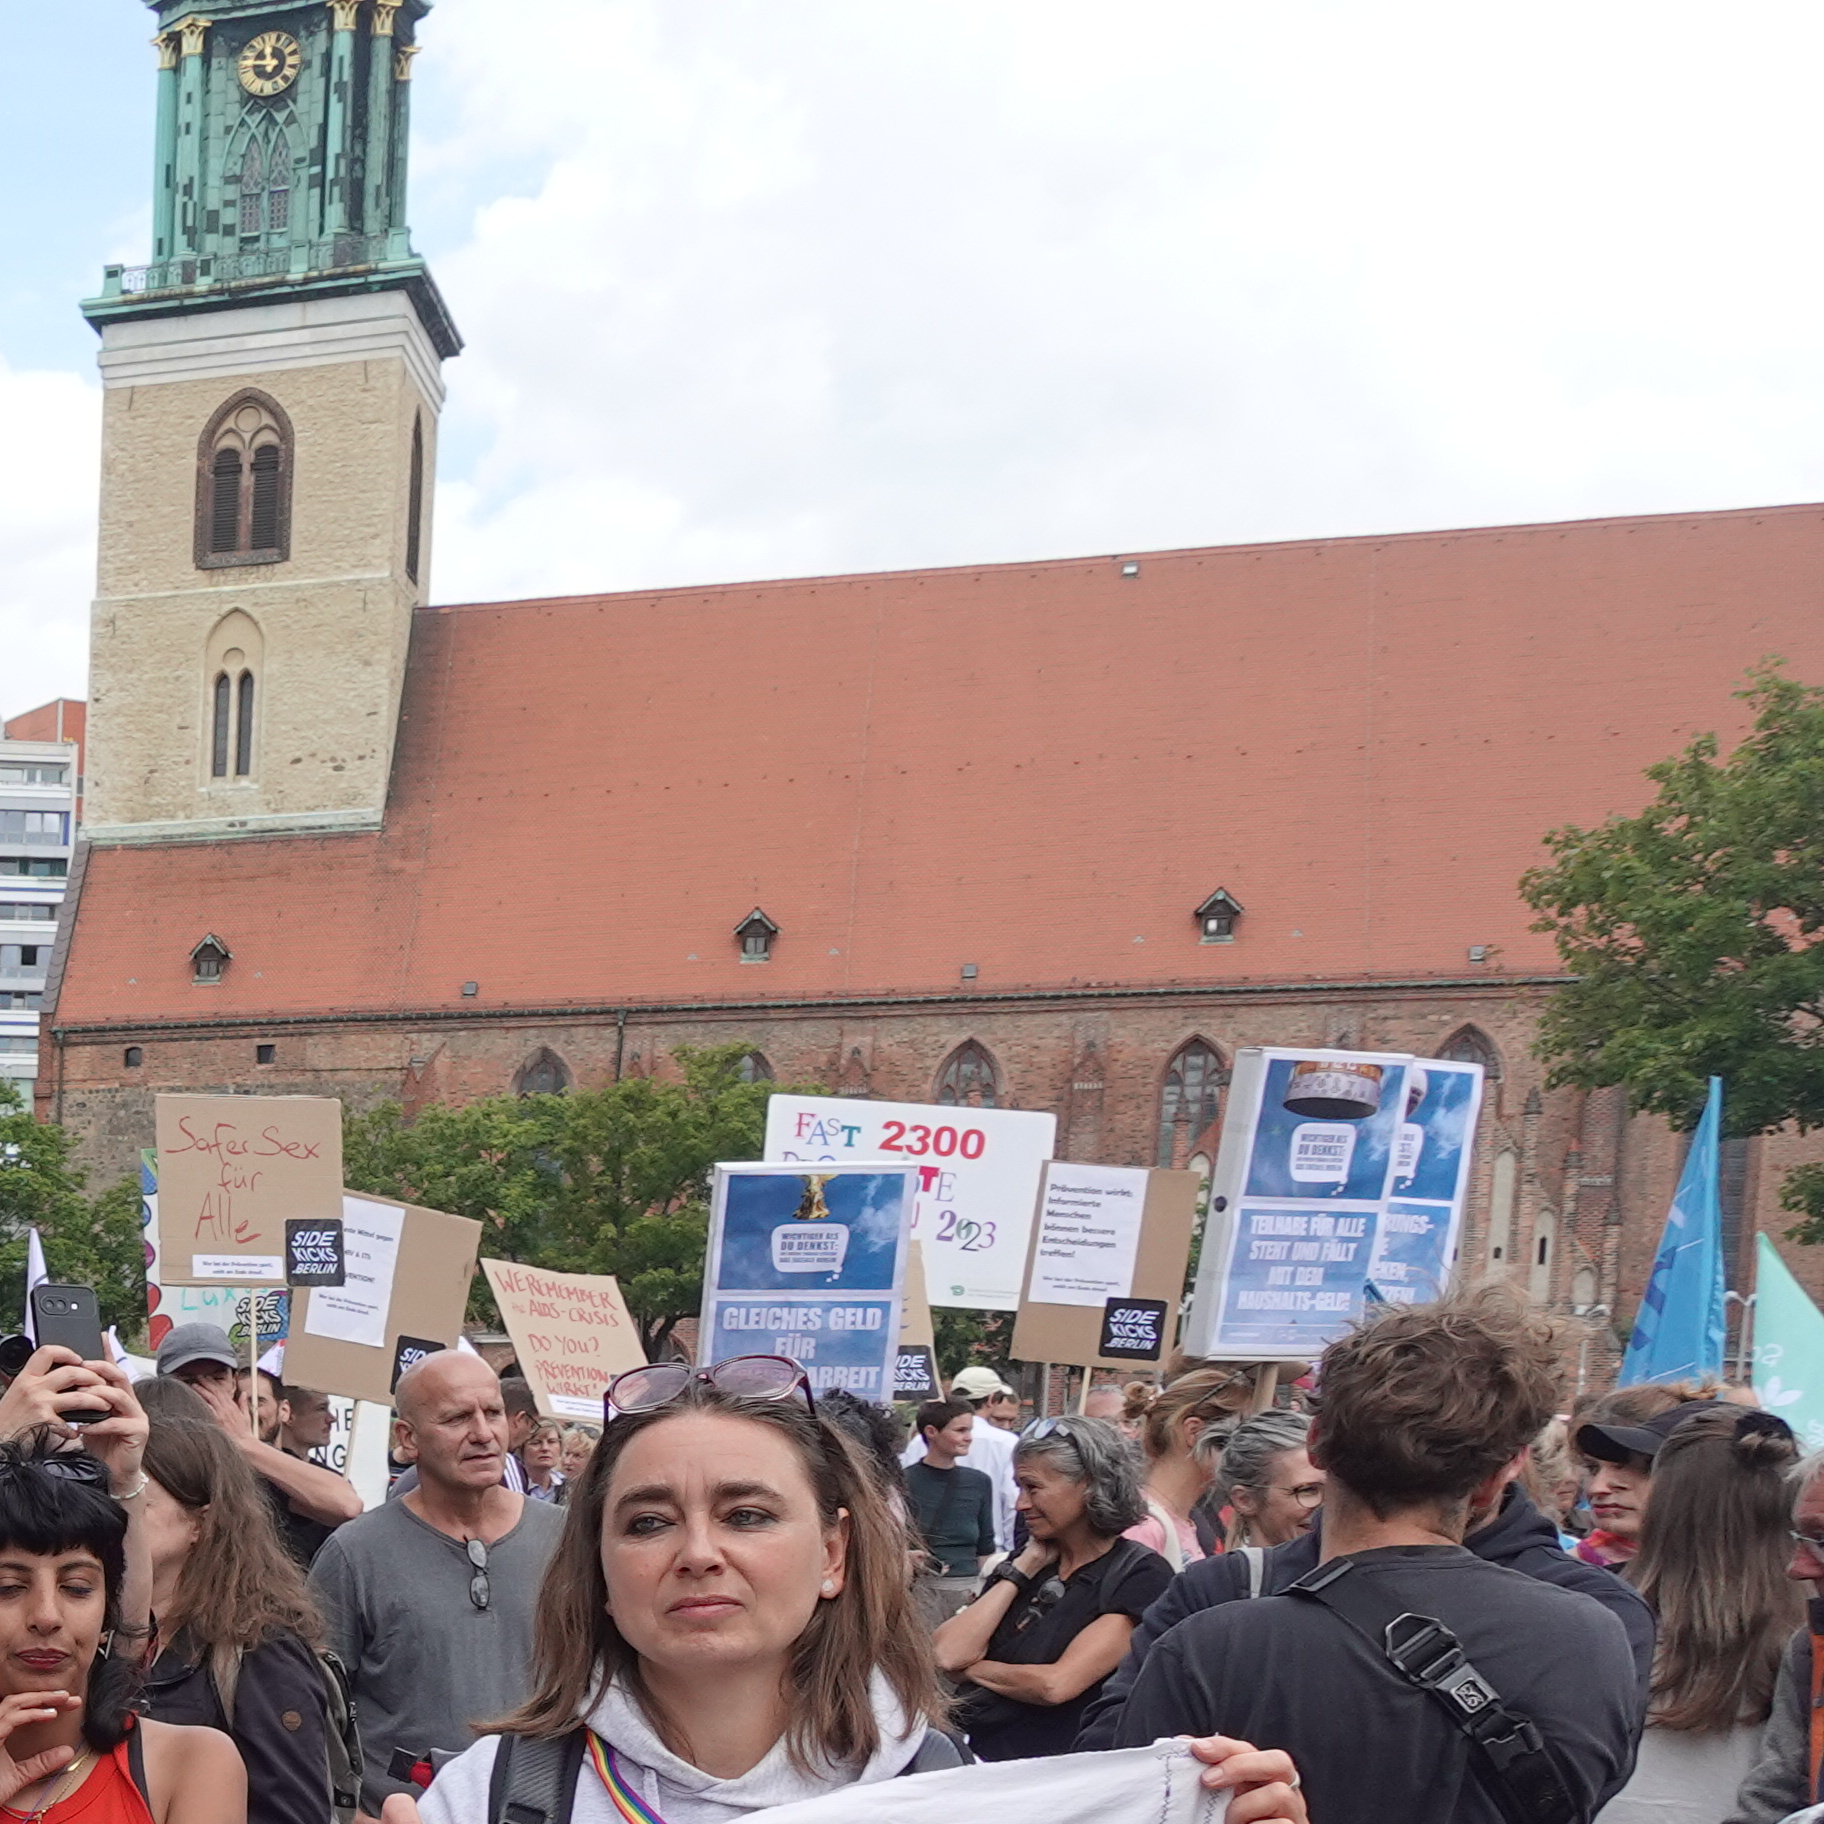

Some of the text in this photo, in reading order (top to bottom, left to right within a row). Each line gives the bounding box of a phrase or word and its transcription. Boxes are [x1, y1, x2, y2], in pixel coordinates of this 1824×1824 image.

[165, 1116, 320, 1165] Safer Sex
[795, 1112, 986, 1160] FAST 2300
[218, 1162, 263, 1193] für
[196, 1192, 262, 1244] Alle
[1309, 1213, 1335, 1237] FÜR
[1335, 1217, 1367, 1237] ALLE
[291, 1231, 337, 1246] SIDE
[935, 1210, 997, 1252] 2023
[291, 1247, 338, 1262] KICKS
[781, 1241, 794, 1250] DU
[291, 1263, 338, 1275] .BERLIN
[494, 1269, 618, 1310] WE REMEMBER
[529, 1299, 619, 1328] AIDS-CRISIS
[722, 1307, 883, 1331] GLEICHES GELD
[1109, 1308, 1160, 1324] SIDE
[1109, 1323, 1157, 1339] KICKS
[528, 1333, 551, 1353] DO
[775, 1333, 816, 1360] FÜR
[1104, 1338, 1155, 1350] .BERLIN
[400, 1348, 427, 1362] SID
[897, 1355, 927, 1368] IDE
